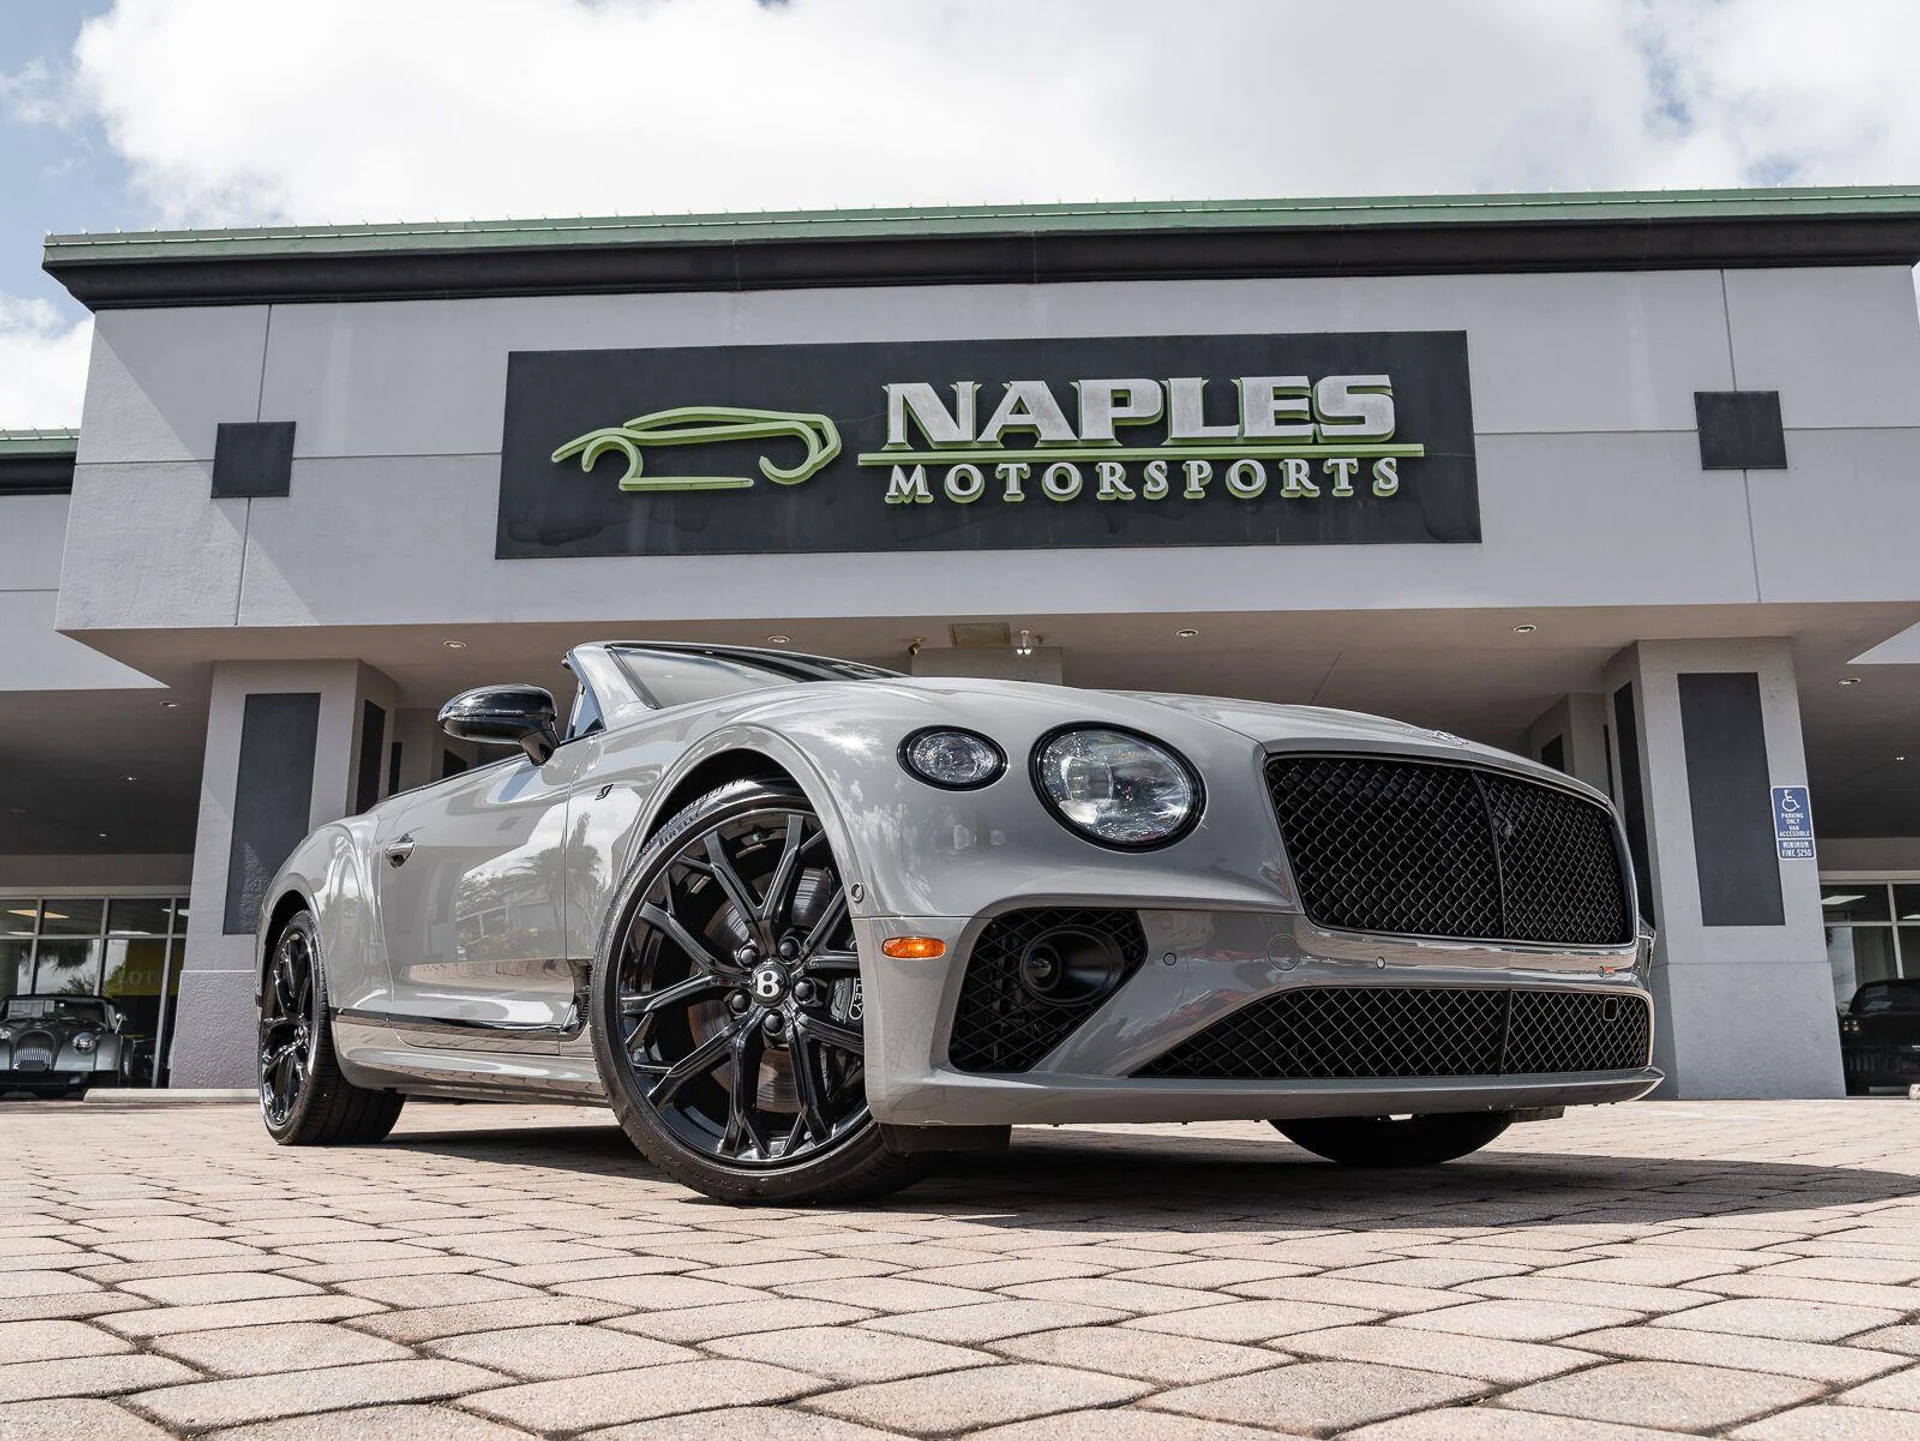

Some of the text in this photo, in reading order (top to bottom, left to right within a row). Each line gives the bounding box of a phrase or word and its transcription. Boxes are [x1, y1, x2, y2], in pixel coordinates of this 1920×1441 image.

[882, 374, 1396, 450] NAPLES
[884, 457, 1400, 504] MOTORSPORTS
[1781, 848, 1812, 857] FINE $250
[1782, 841, 1810, 849] MINIMUM
